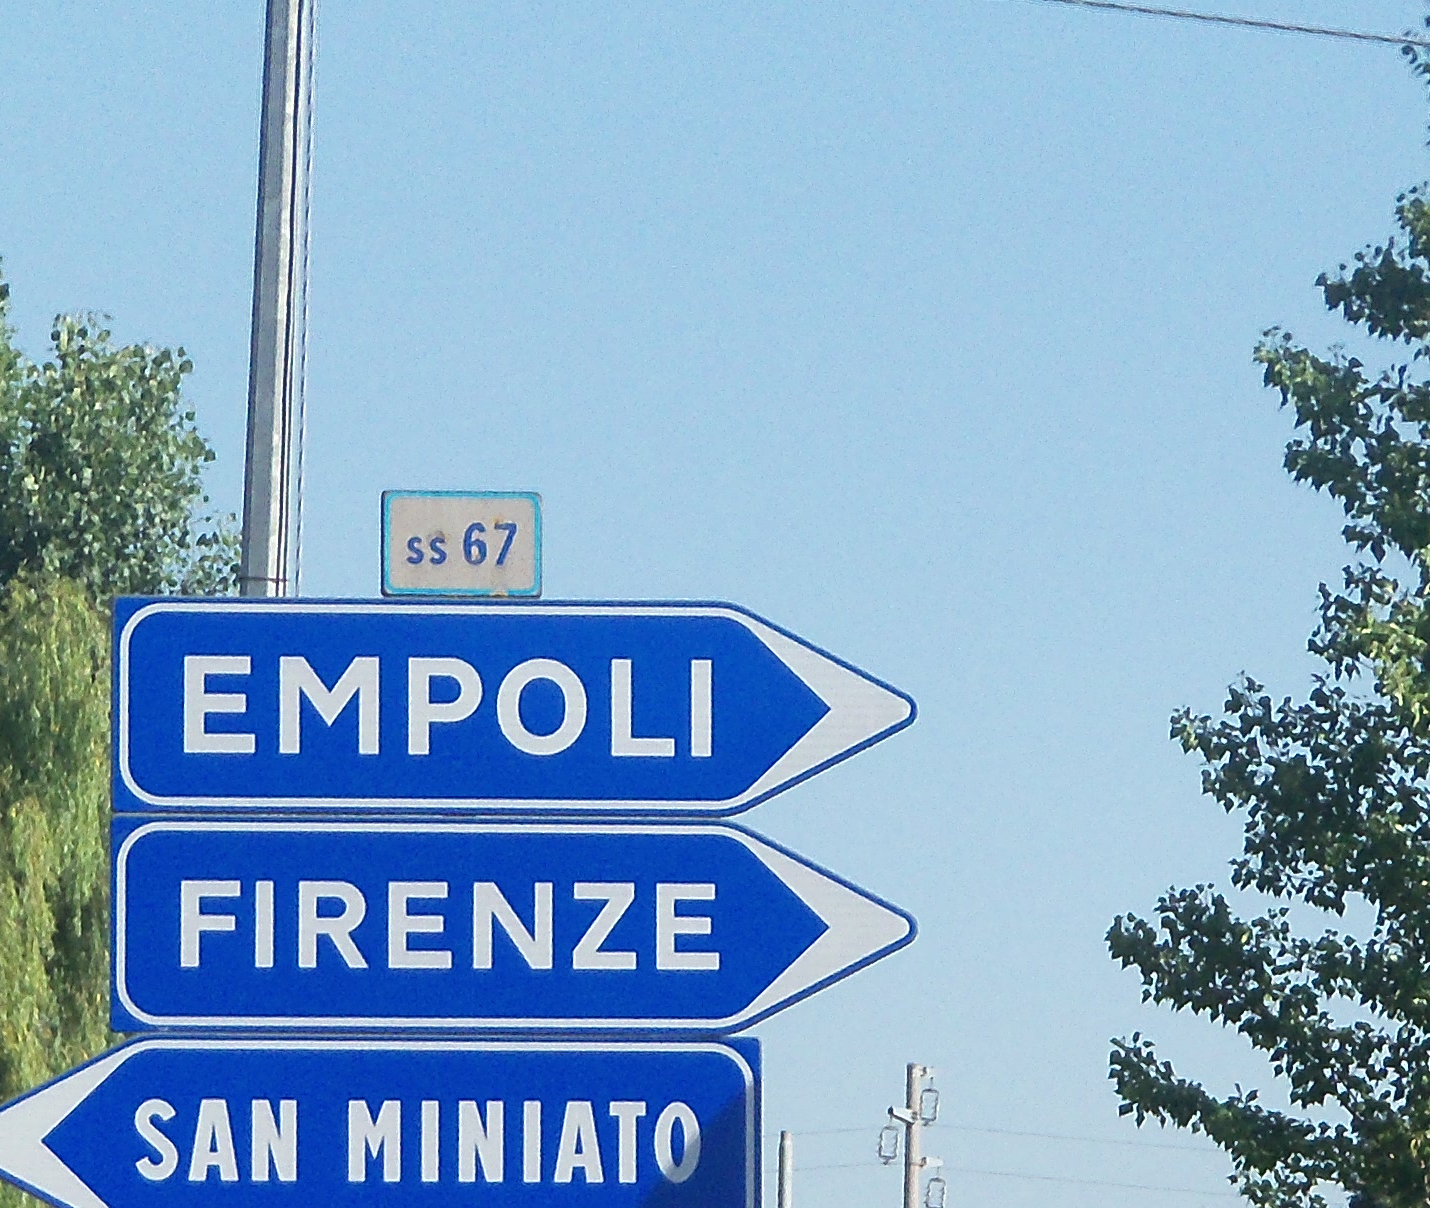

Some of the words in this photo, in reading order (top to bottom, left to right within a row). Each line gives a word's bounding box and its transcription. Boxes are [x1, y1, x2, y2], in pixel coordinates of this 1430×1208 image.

[406, 536, 448, 566] ss
[463, 522, 518, 567] 67
[183, 655, 713, 758] EMPOLI
[180, 880, 721, 971] FIRENZE
[134, 1098, 299, 1182] SAN
[347, 1099, 701, 1184] MINIATO
